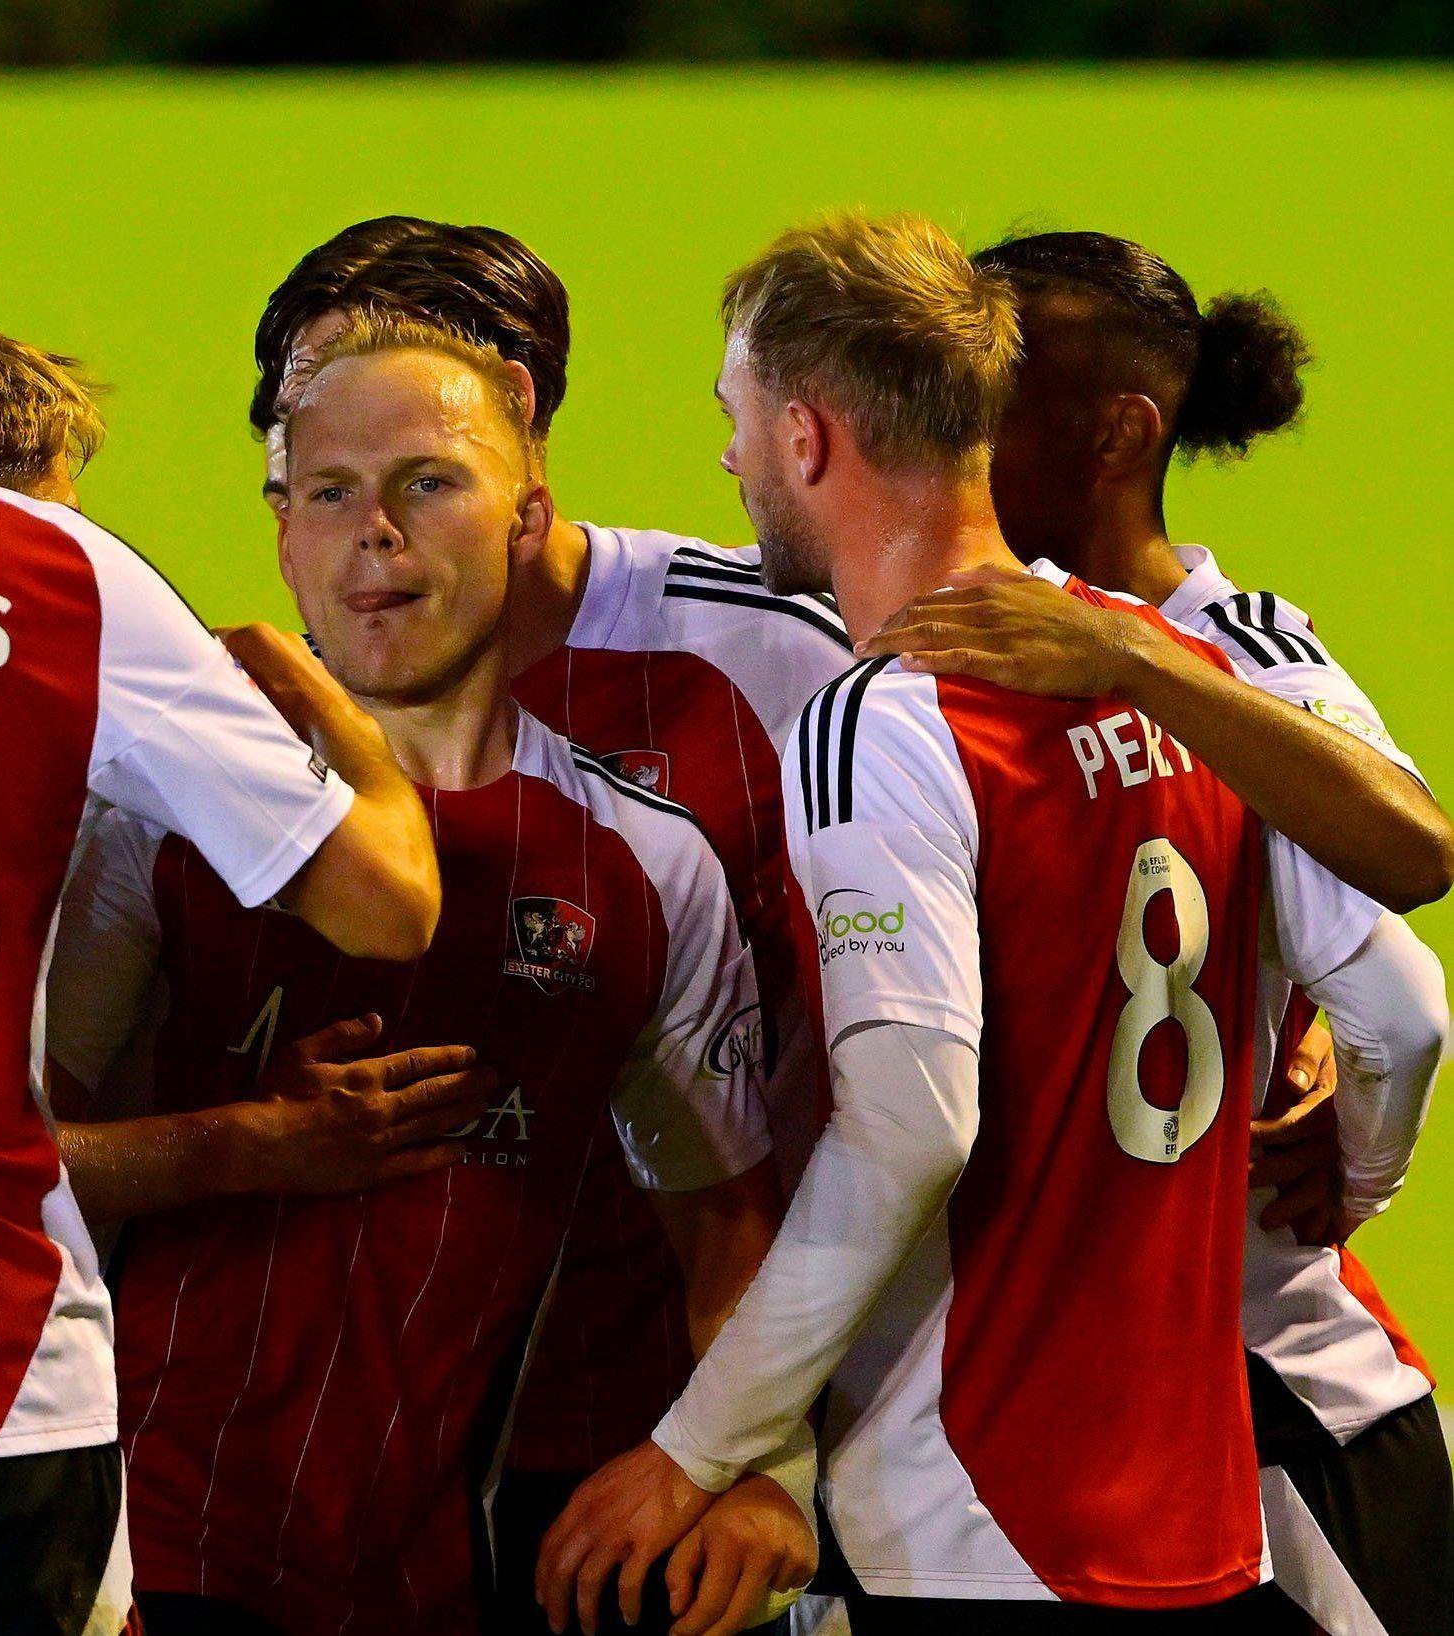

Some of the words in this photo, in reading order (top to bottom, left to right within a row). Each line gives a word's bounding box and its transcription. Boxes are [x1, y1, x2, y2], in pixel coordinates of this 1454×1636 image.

[849, 938, 869, 954] by
[875, 940, 905, 954] you
[506, 961, 551, 979] EXETER
[553, 970, 576, 984] CITY
[1106, 838, 1224, 1163] 8
